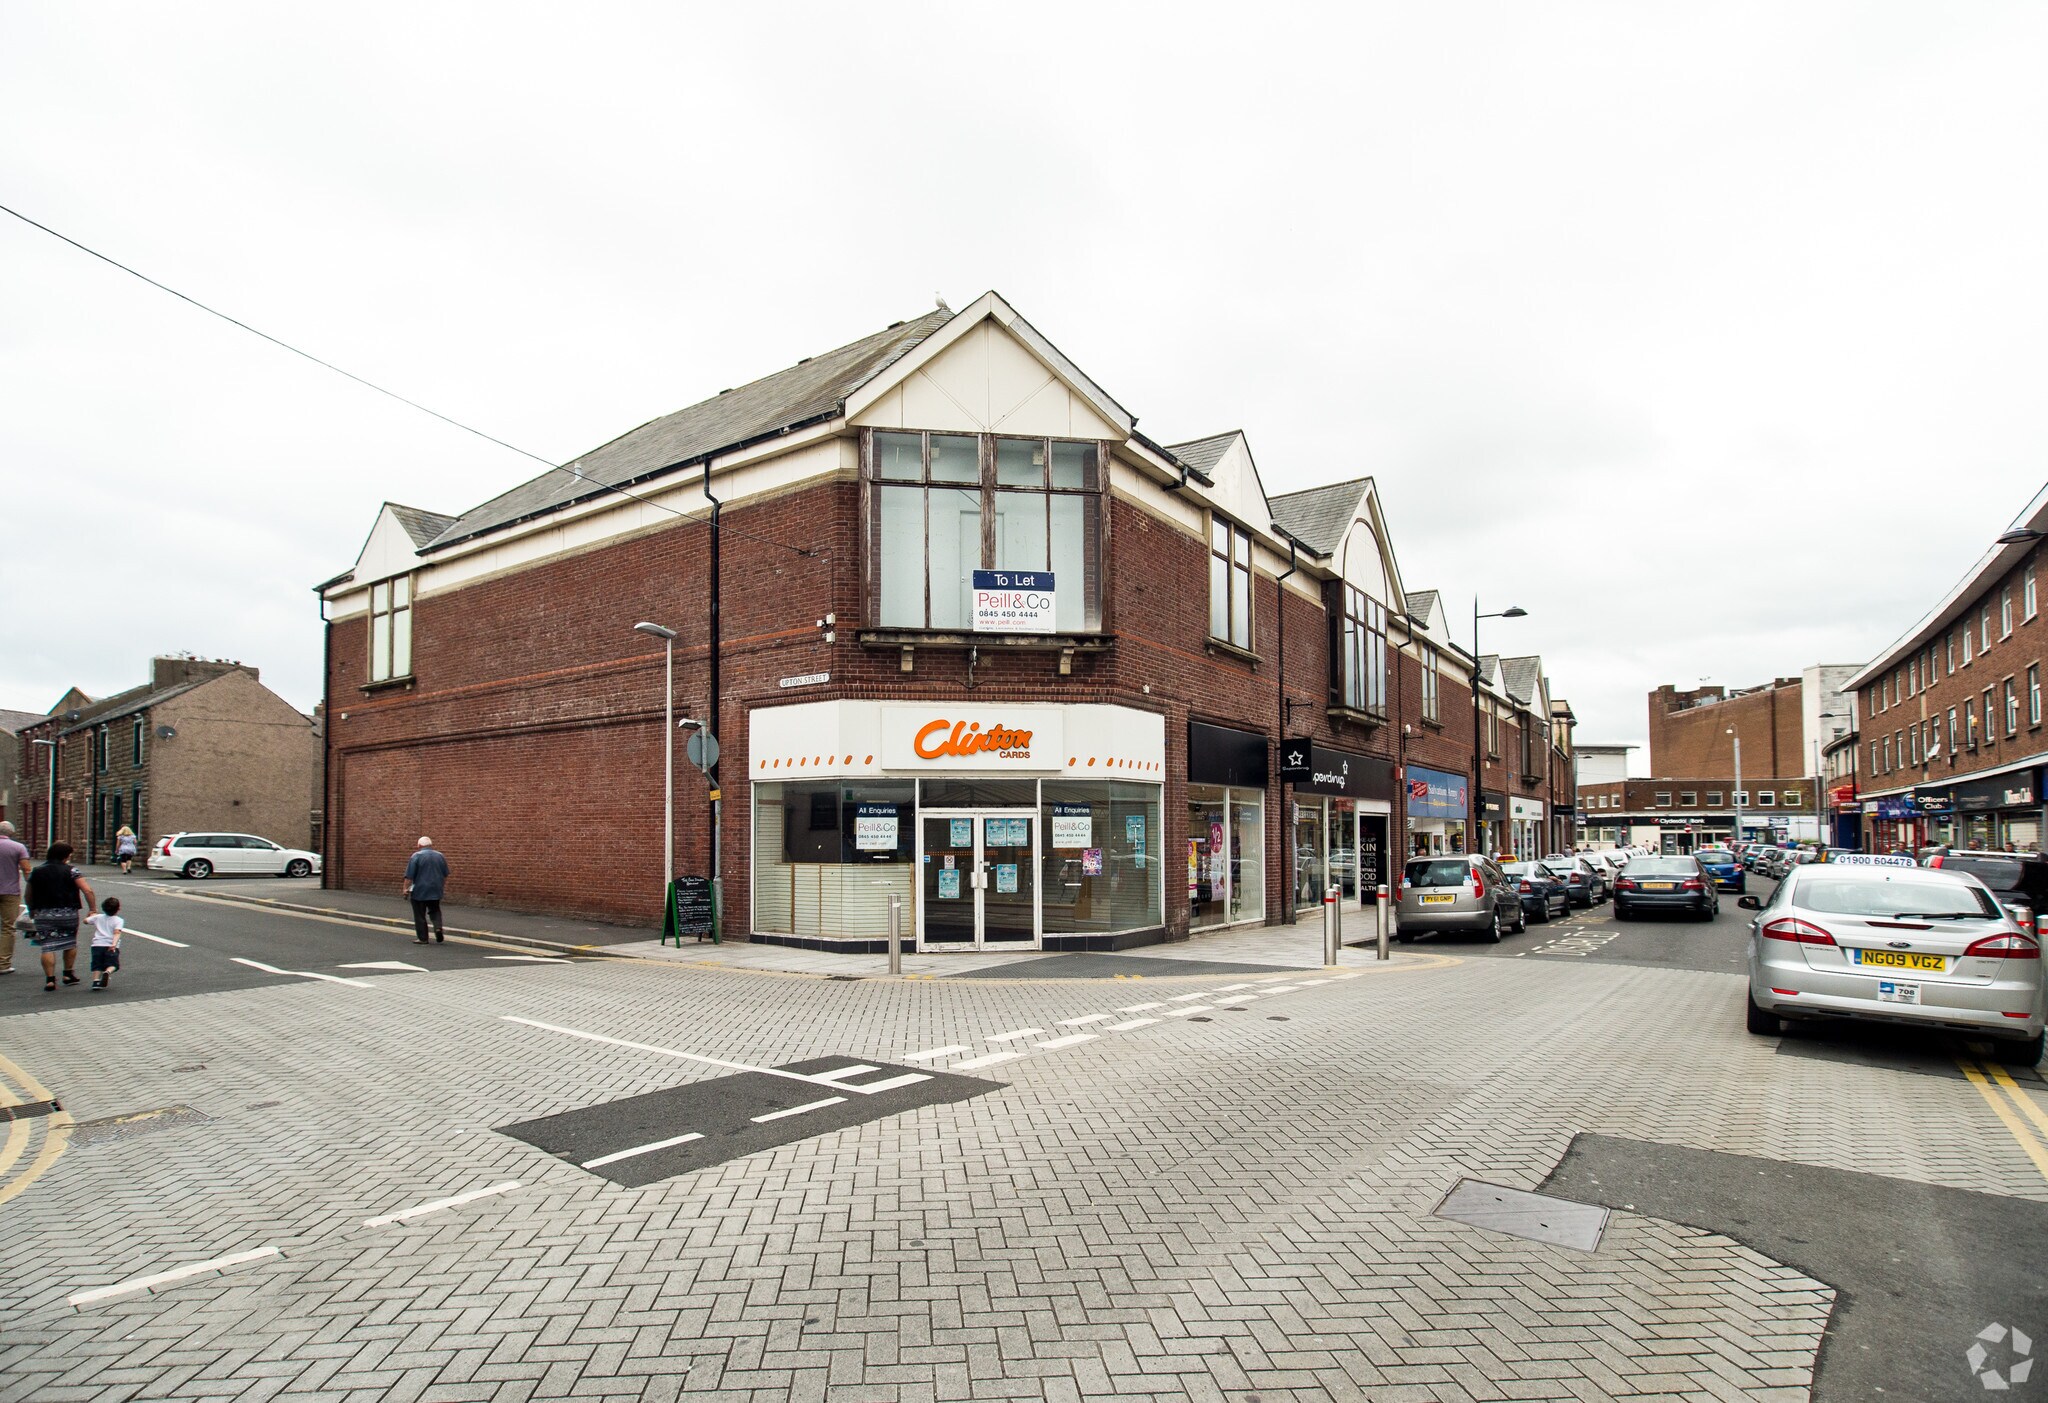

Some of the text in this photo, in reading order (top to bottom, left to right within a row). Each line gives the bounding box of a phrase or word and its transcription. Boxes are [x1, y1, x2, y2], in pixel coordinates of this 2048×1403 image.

[994, 574, 1034, 586] To Let
[978, 592, 1050, 610] Peill&Co
[781, 674, 827, 687] UPTON STREET
[914, 719, 1033, 759] Clinton
[999, 751, 1031, 759] CARDS
[1312, 770, 1346, 789] perdrug
[868, 806, 896, 815] Enquiries
[1054, 806, 1090, 815] All Enquiries
[1360, 843, 1376, 852] KIN
[1360, 857, 1376, 867] AIR
[1840, 855, 1913, 867] 01900 604478
[1360, 872, 1376, 880] OOD
[1864, 951, 1943, 969] NG09 VGZ
[1898, 988, 1915, 996] 708
